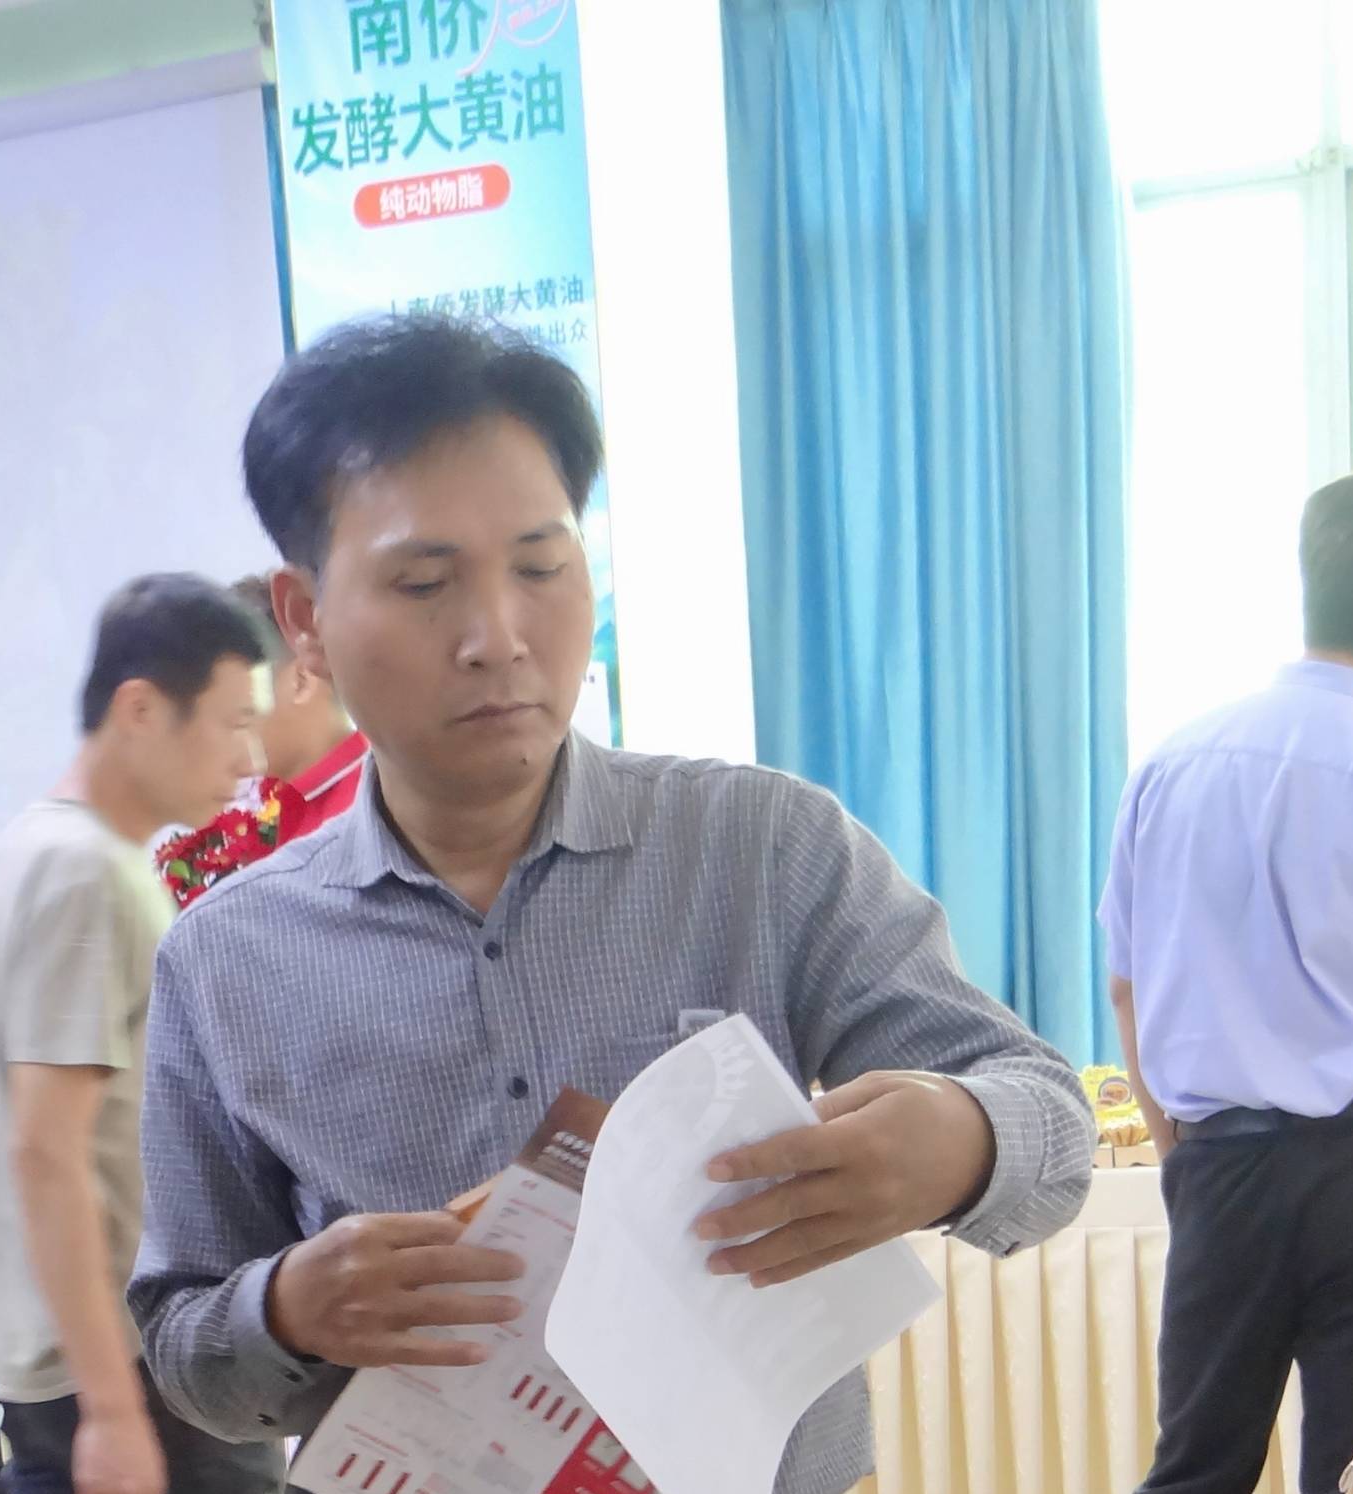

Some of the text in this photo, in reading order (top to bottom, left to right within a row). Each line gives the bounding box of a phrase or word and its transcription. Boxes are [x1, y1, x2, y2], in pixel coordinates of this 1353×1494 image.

[292, 62, 566, 176] 发酵大黄油
[379, 173, 485, 221] 纯动物脂
